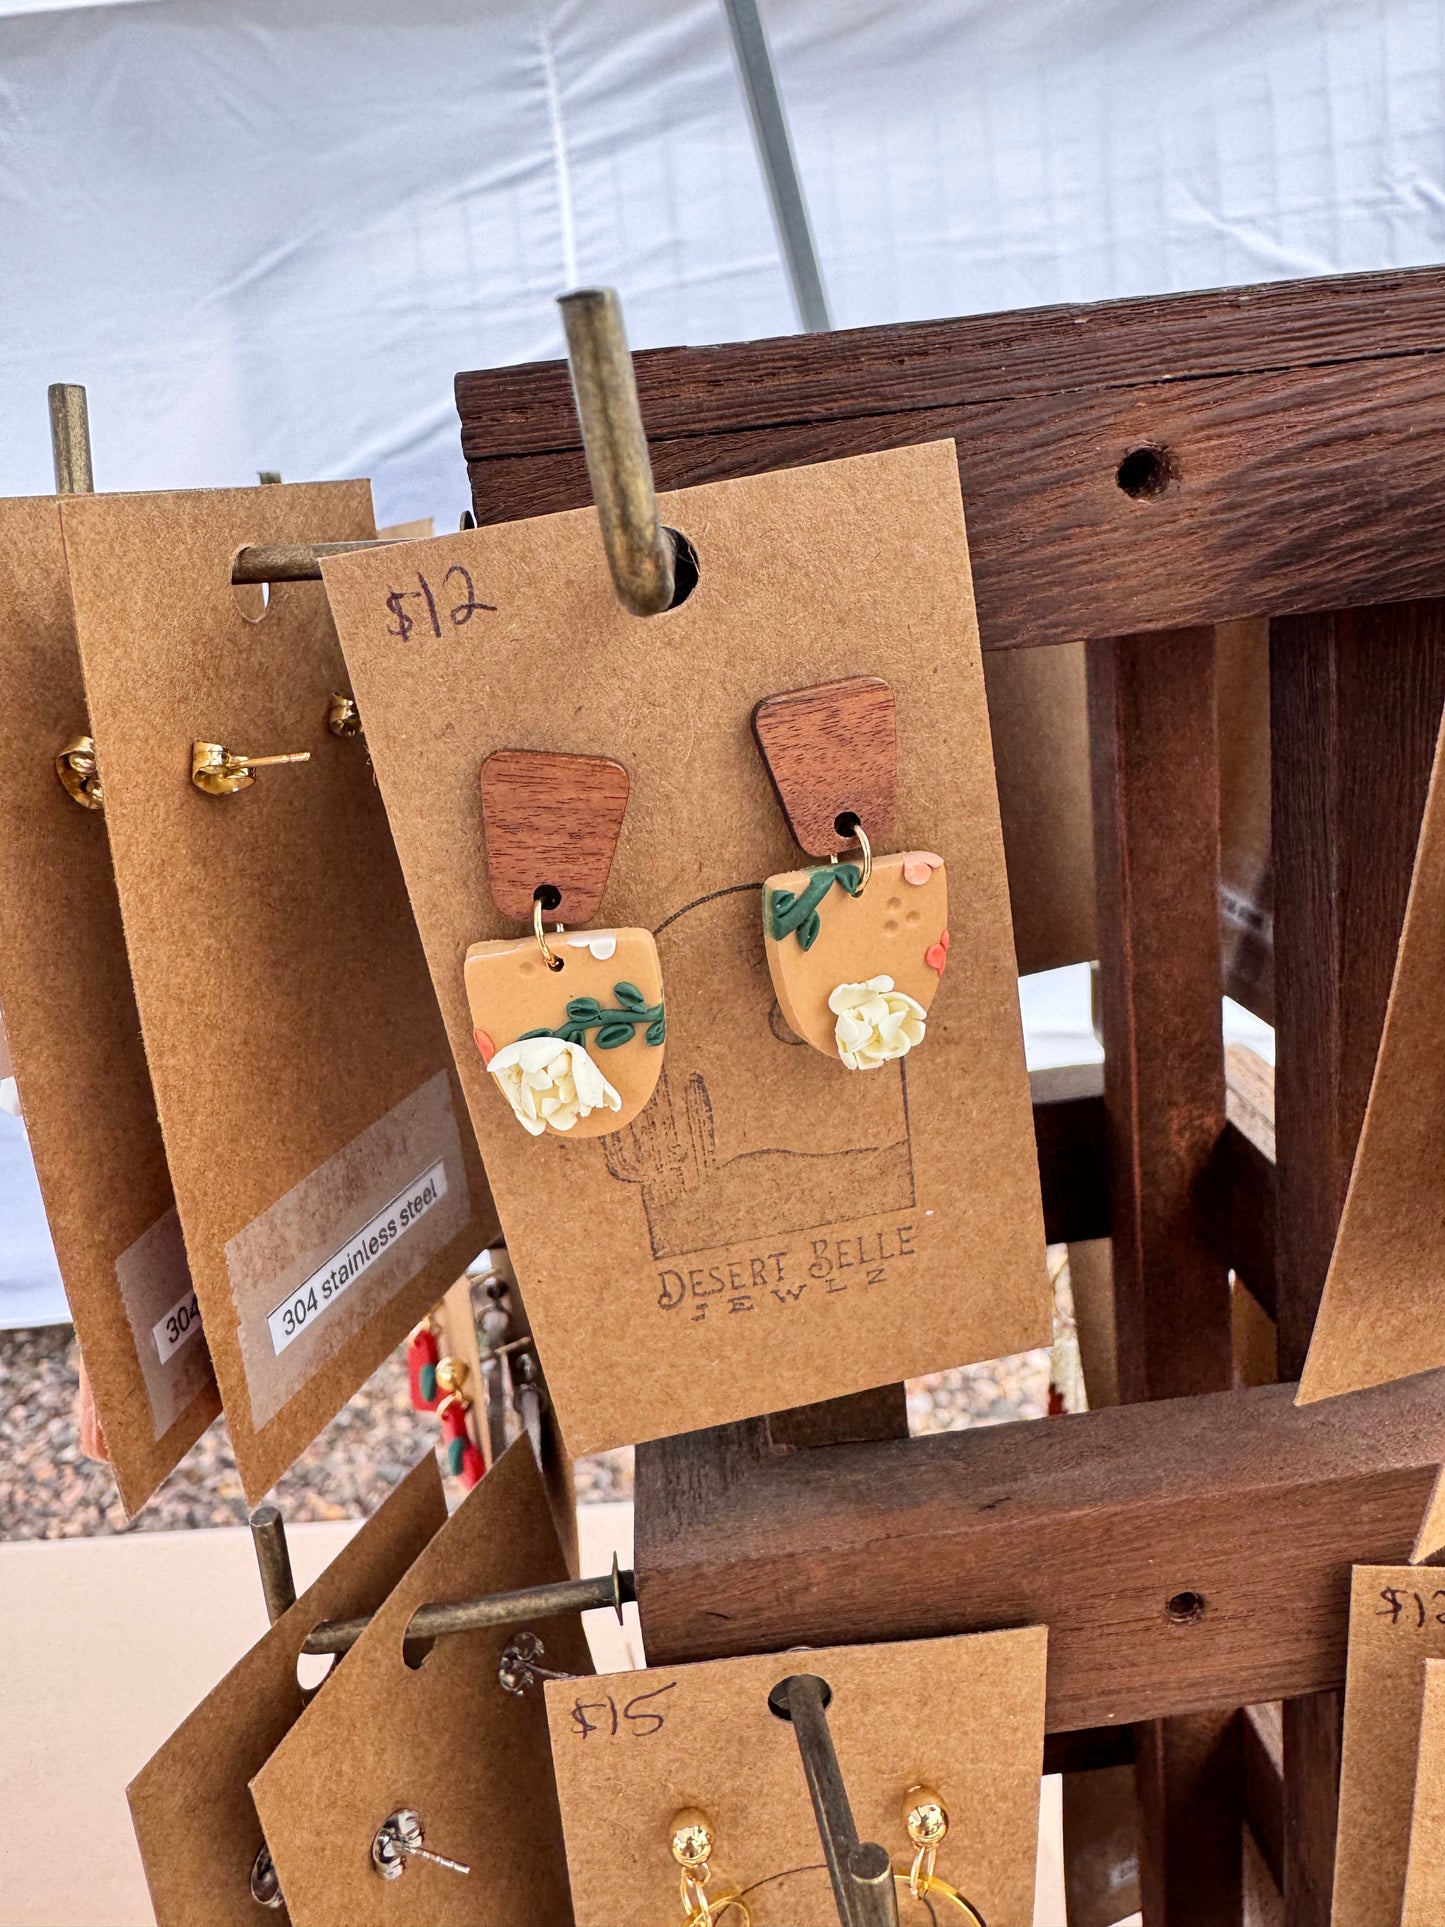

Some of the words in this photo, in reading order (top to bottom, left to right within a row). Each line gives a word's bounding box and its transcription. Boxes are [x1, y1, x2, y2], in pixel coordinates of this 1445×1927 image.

[386, 565, 498, 643] $12
[282, 1286, 319, 1336] 304
[321, 1218, 398, 1300] stainless
[399, 1177, 438, 1228] steel
[656, 1251, 788, 1311] DESERT
[808, 1225, 916, 1279] BELLE
[571, 1681, 677, 1741] $15
